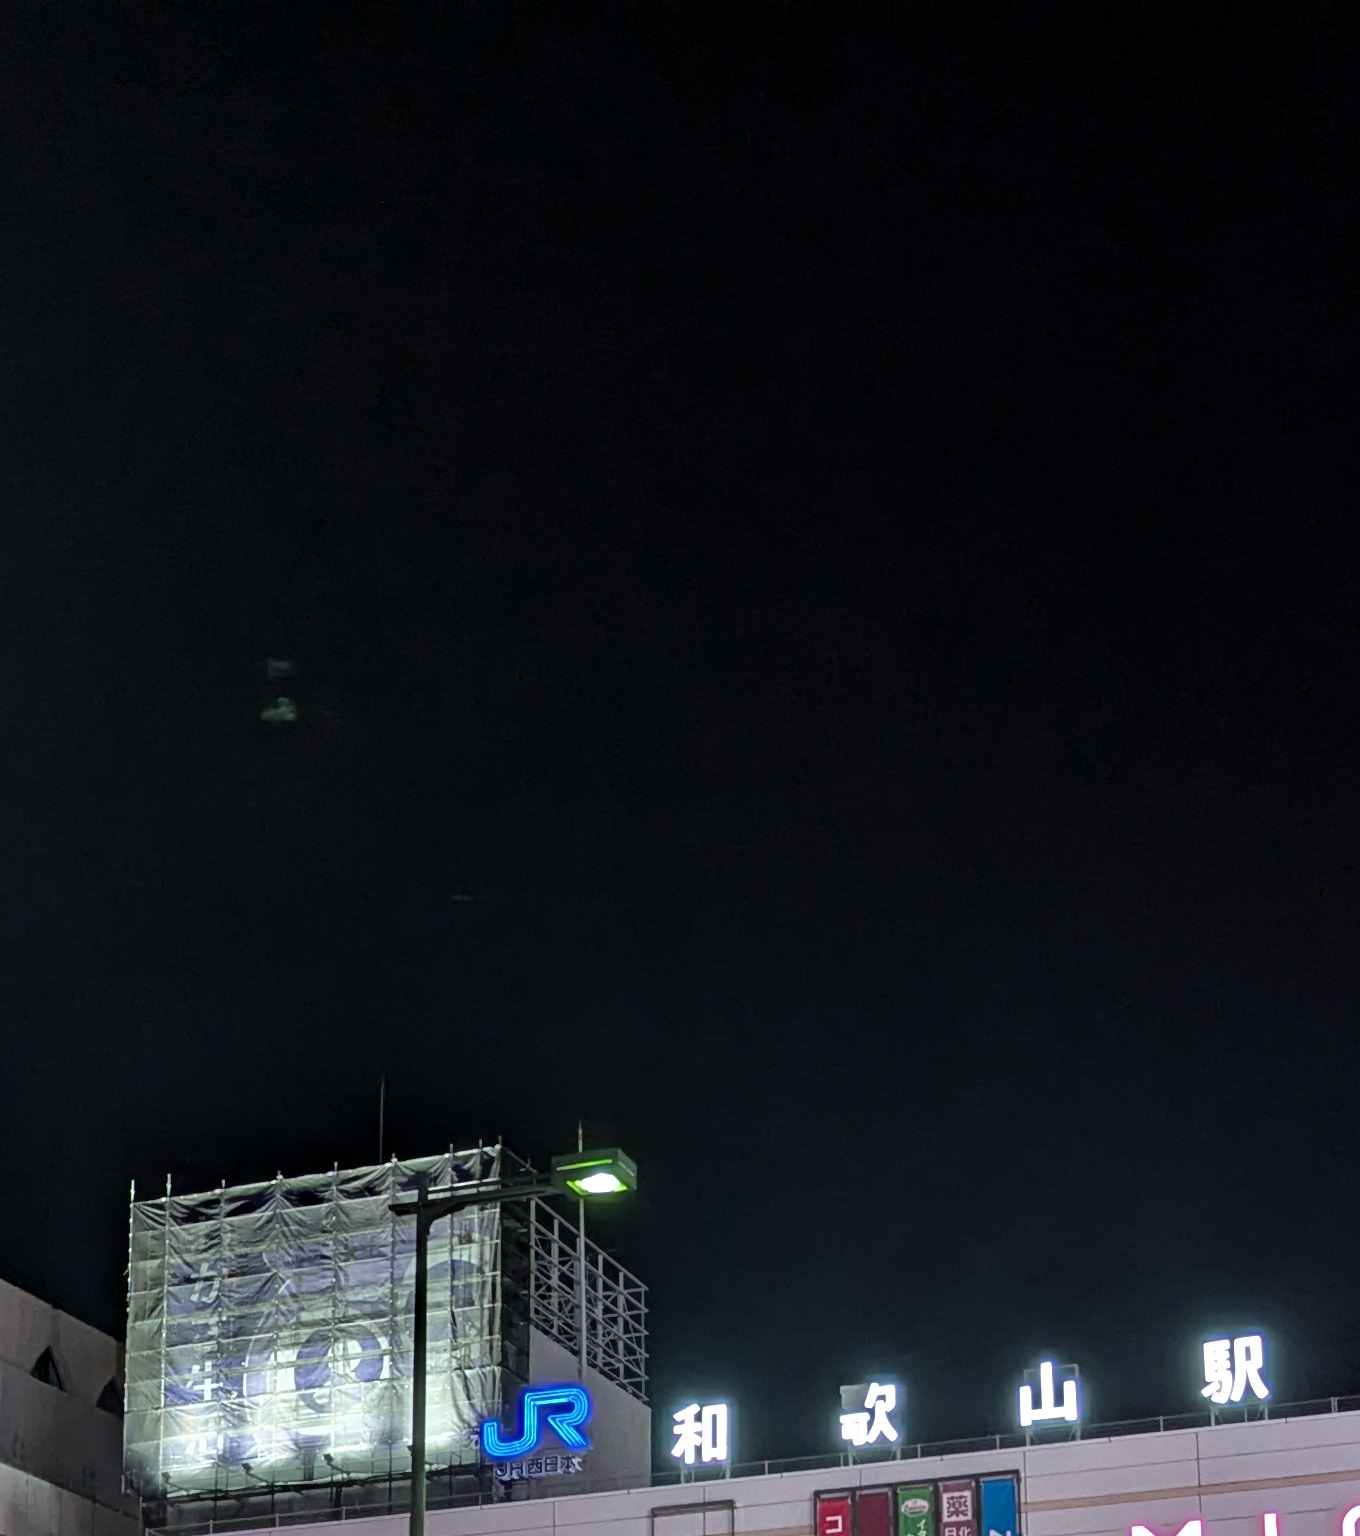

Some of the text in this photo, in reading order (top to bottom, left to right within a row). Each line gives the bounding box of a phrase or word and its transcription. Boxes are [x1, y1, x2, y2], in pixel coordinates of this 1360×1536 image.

[483, 1388, 588, 1457] JR
[494, 1455, 577, 1478] JR西日本
[946, 1494, 970, 1519] 薬
